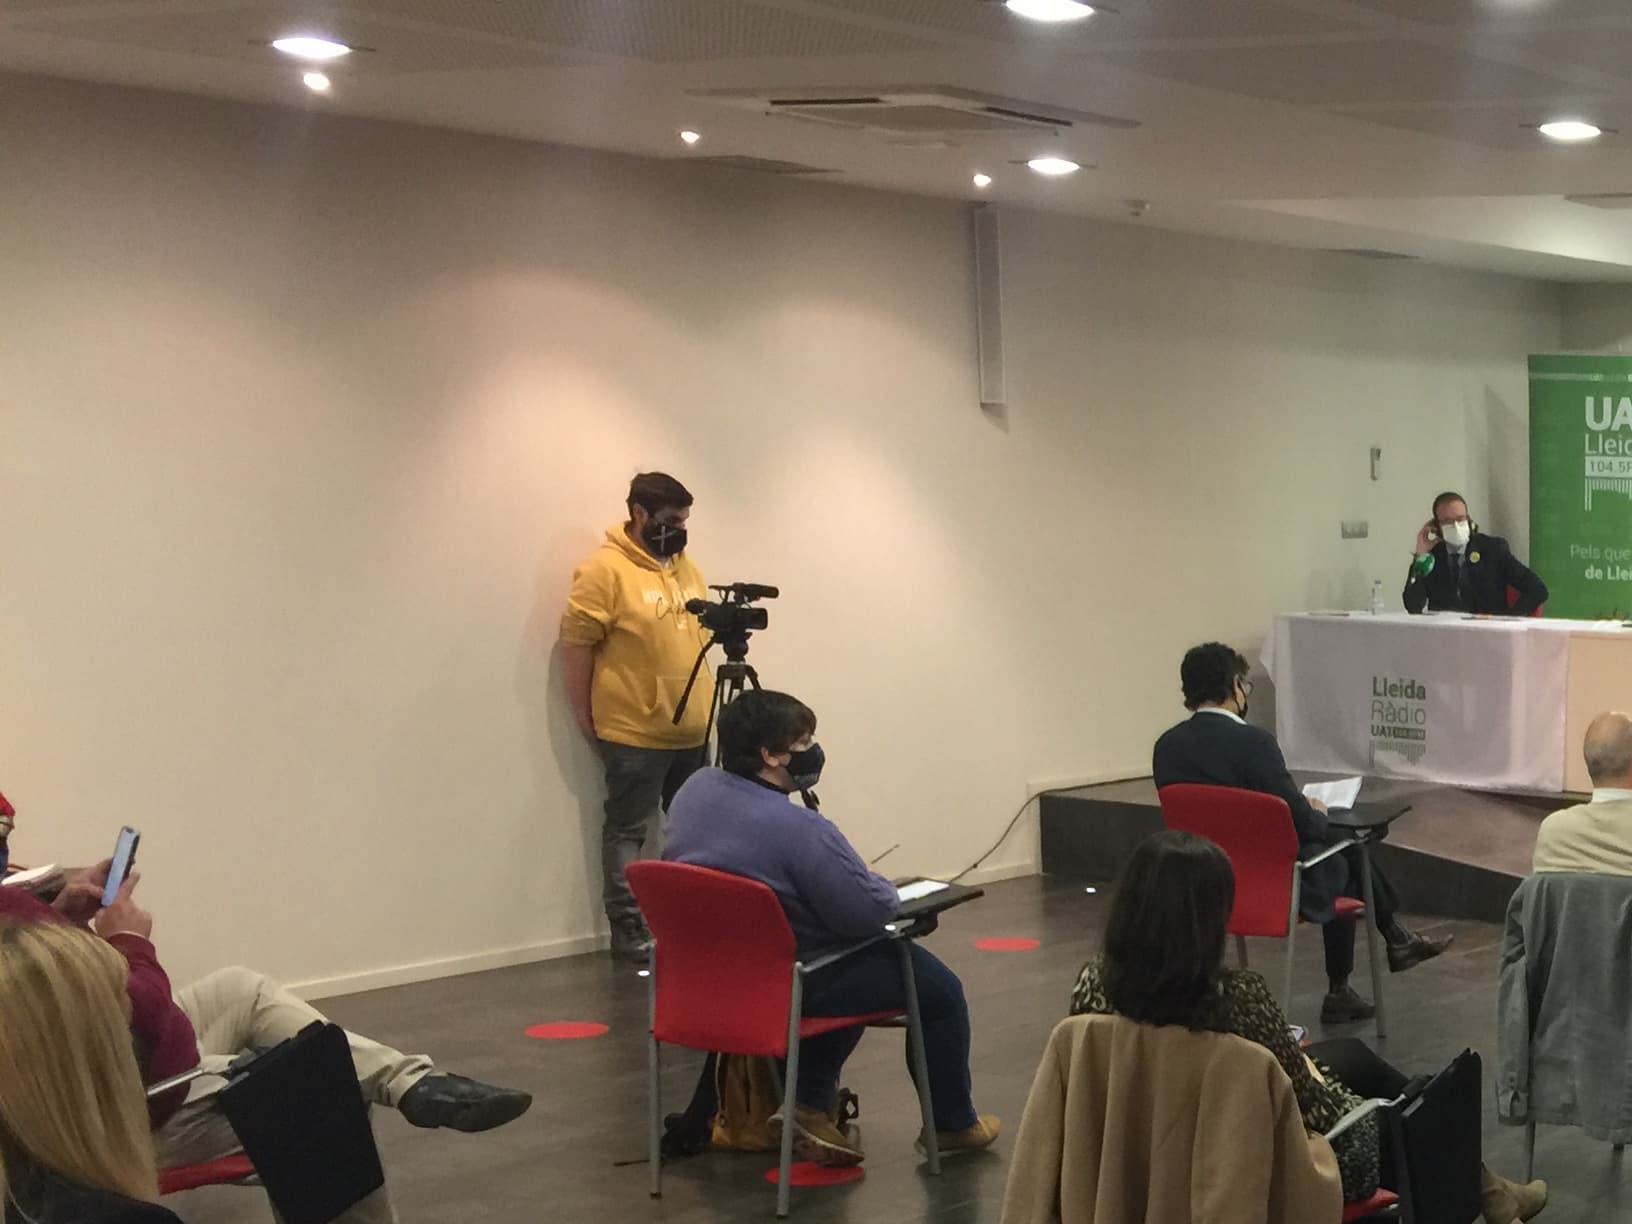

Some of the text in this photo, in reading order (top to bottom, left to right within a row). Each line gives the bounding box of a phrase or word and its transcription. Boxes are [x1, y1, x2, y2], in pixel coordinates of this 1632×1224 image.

[1570, 543, 1600, 560] Pels
[1604, 547, 1632, 563] que
[1584, 564, 1603, 580] de
[1372, 676, 1426, 700] Lleida
[1371, 699, 1426, 725] Ràdio
